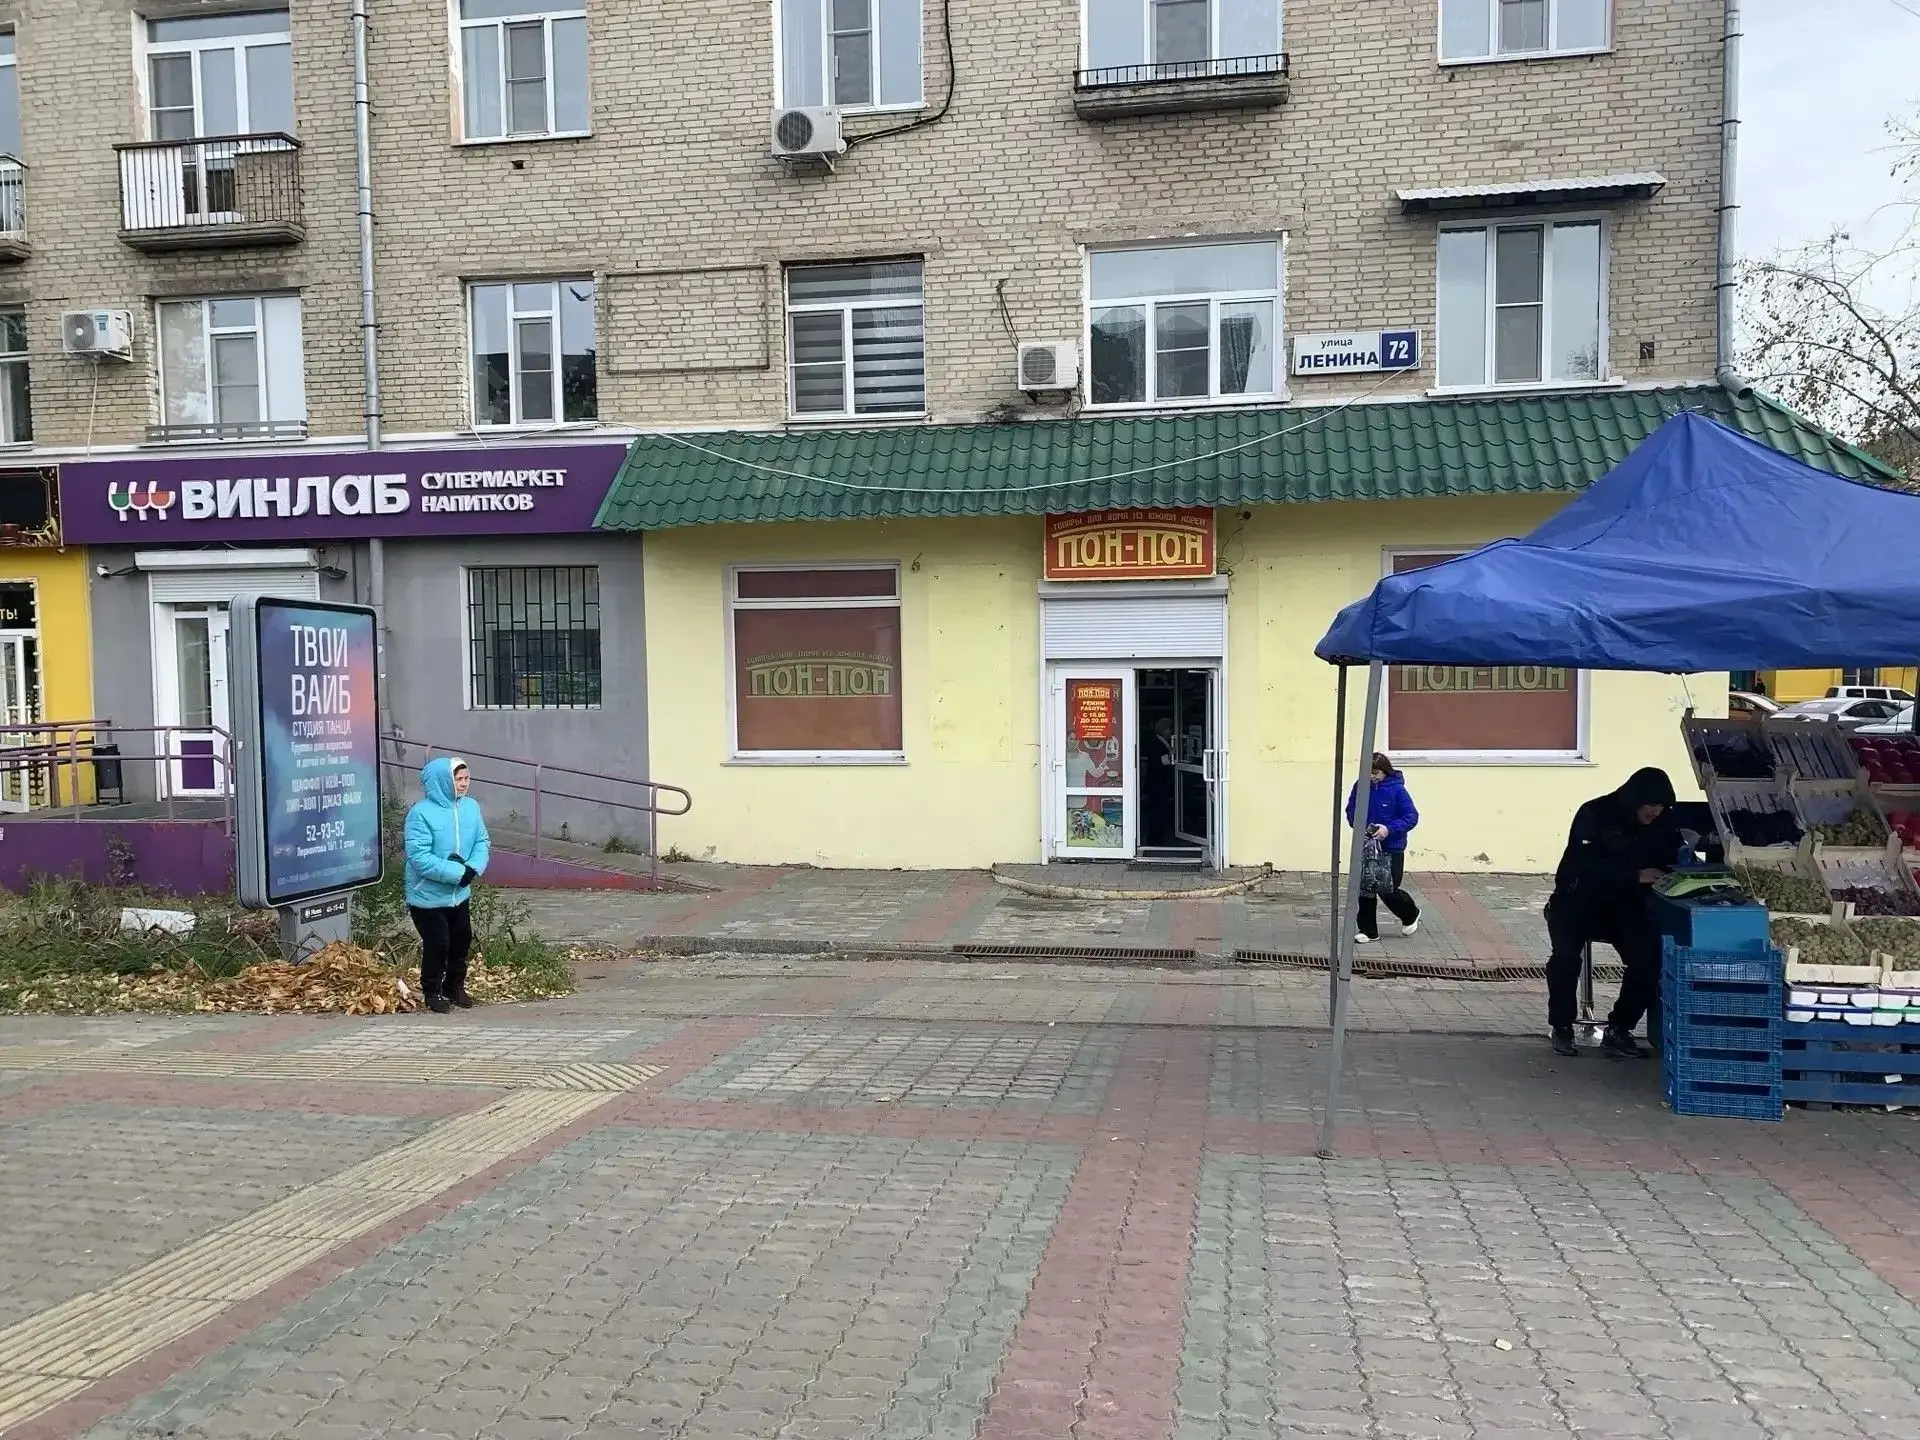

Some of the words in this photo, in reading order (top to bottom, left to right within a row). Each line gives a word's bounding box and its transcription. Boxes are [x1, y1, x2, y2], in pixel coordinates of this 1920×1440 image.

[1321, 338, 1353, 350] улица
[1388, 340, 1409, 360] 72
[1299, 351, 1379, 369] ЛЕНИНА
[420, 468, 568, 490] СУПЕРМАРКЕТ
[420, 492, 535, 513] НАПИТКОВ
[1053, 517, 1083, 531] ТОВАРЫ
[1087, 514, 1102, 524] ДЛЯ
[1107, 512, 1129, 521] ДОМА
[1148, 512, 1177, 522] ЮЖНОЙ
[1058, 529, 1203, 567] ПОН-ПОН
[290, 624, 348, 668] ТВОЙ
[751, 664, 889, 695] ПОН-ПОН
[291, 674, 351, 716] ВАЙБ
[292, 721, 324, 738] СТУДИЯ
[326, 719, 352, 736] ТАНЦА
[322, 793, 341, 810] ДЖАЗ
[306, 820, 345, 842] 52-93-52
